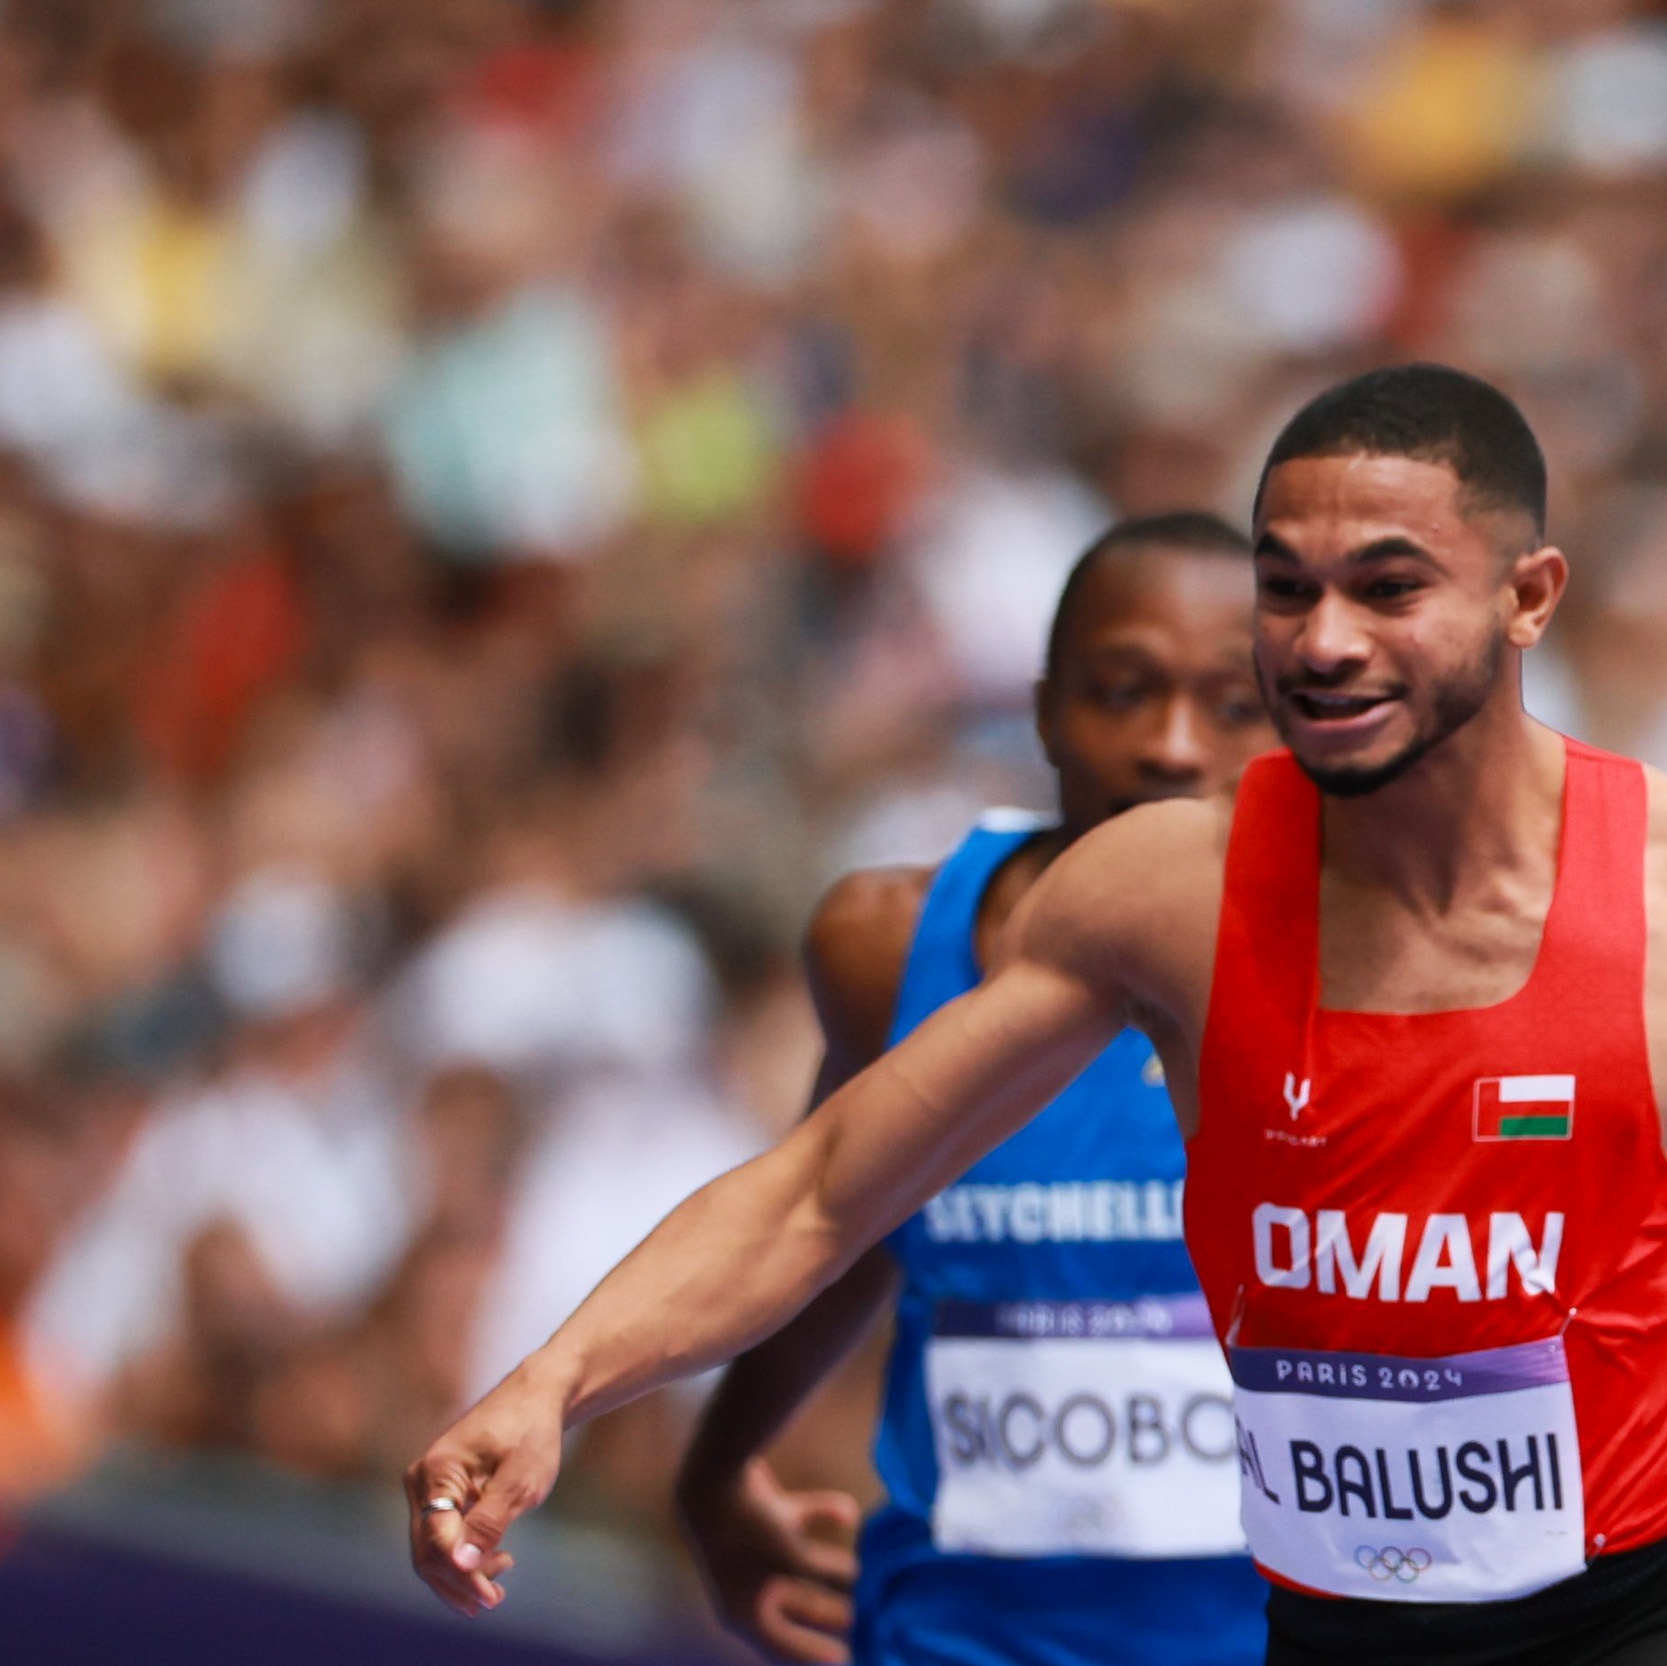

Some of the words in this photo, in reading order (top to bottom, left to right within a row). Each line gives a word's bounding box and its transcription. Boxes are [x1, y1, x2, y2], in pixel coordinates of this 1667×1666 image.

[1252, 1202, 1565, 1303] OMAN
[1276, 1359, 1367, 1389] PARIS
[1378, 1367, 1462, 1391] 2024
[1289, 1432, 1563, 1521] BALUSHI
